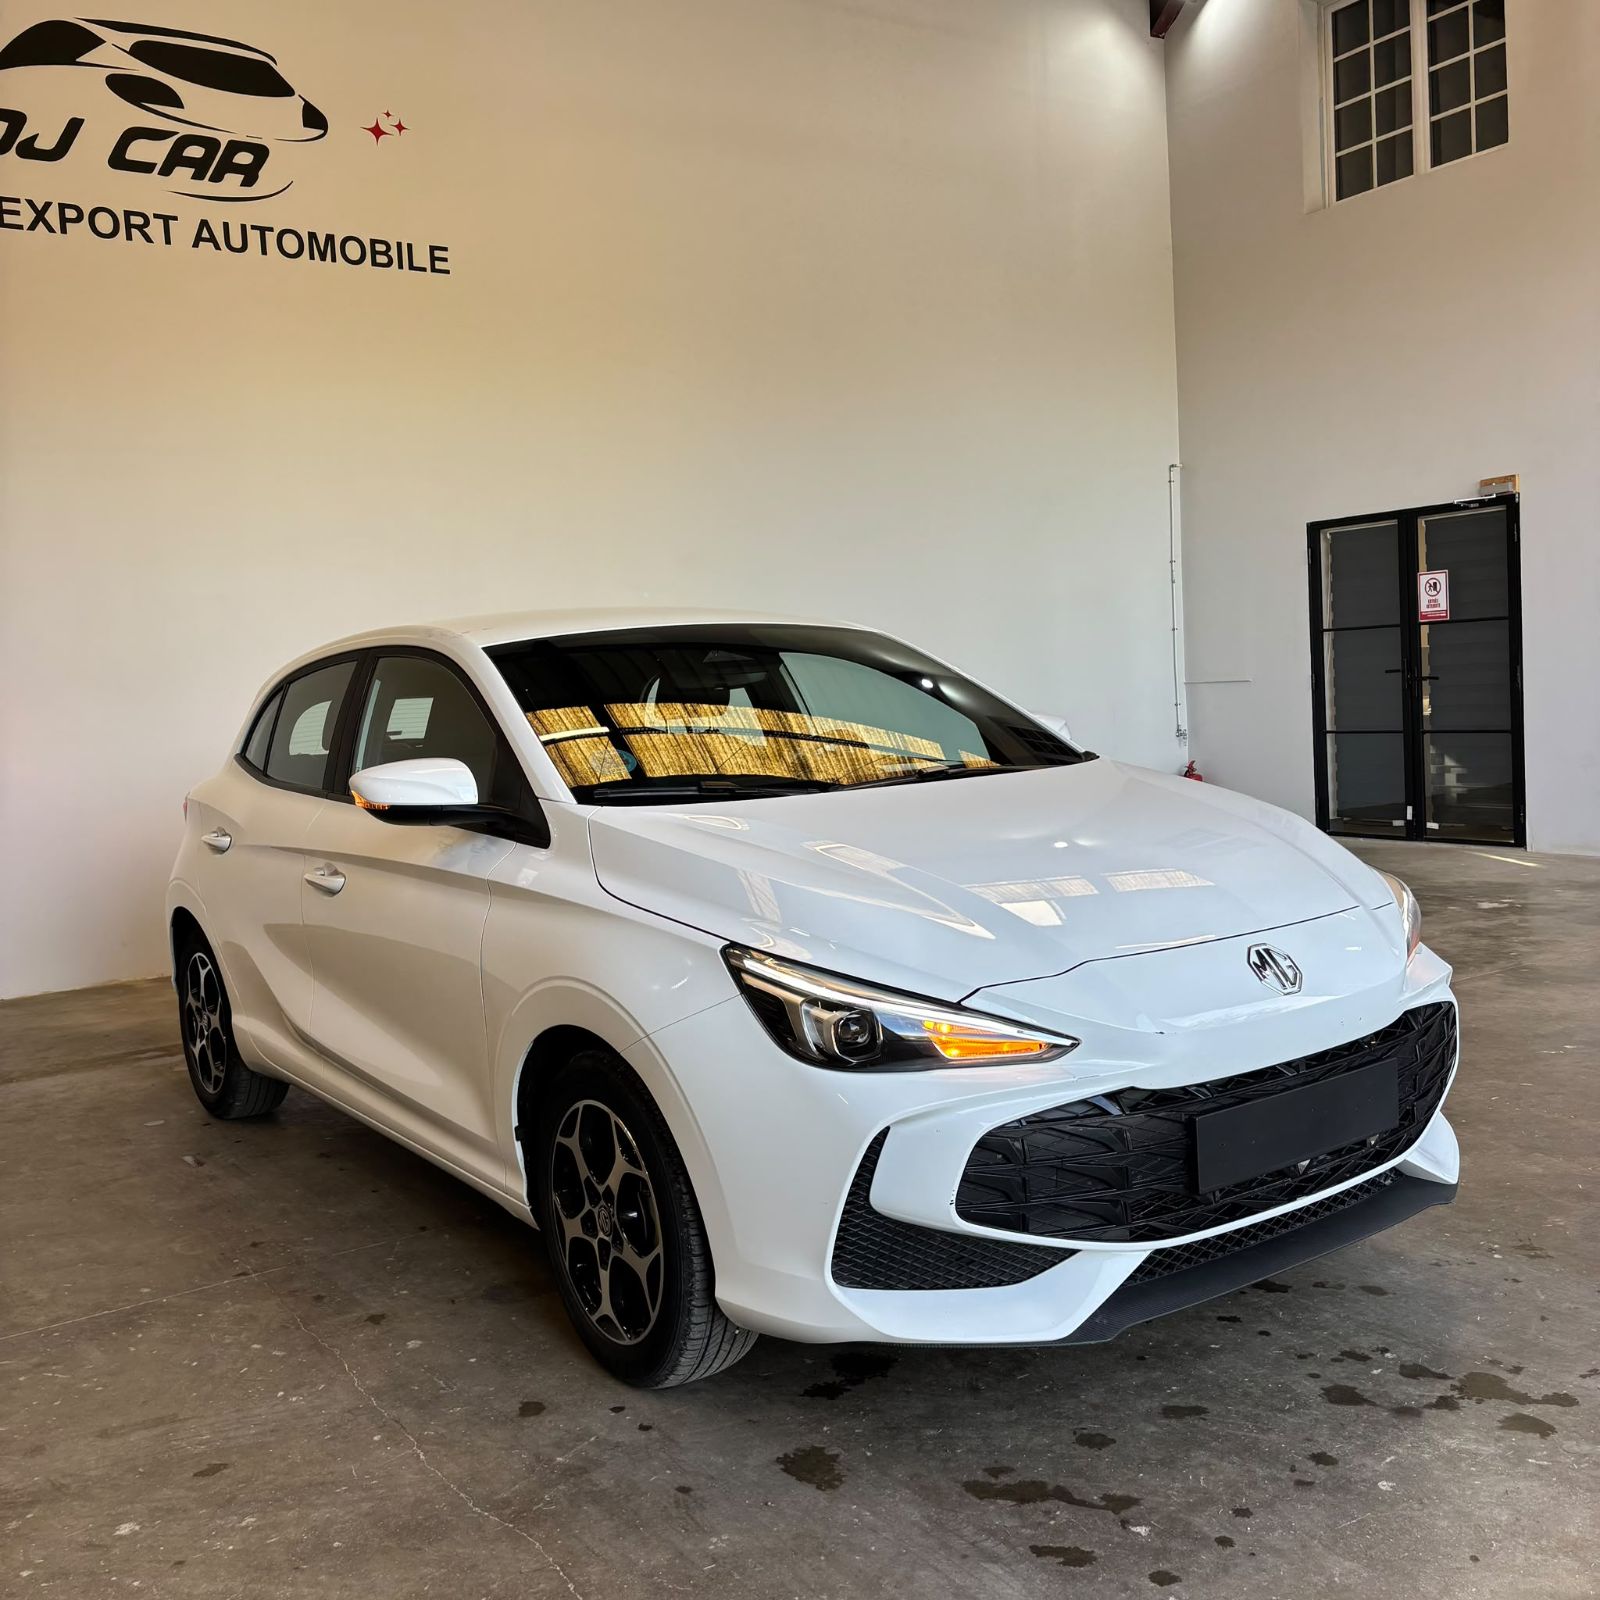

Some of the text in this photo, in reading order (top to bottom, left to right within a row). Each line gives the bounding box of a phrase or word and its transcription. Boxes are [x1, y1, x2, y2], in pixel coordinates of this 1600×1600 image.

[107, 126, 270, 188] CAR
[0, 195, 451, 275] EXPORT AUTOMOBILE
[1250, 945, 1300, 992] MG
